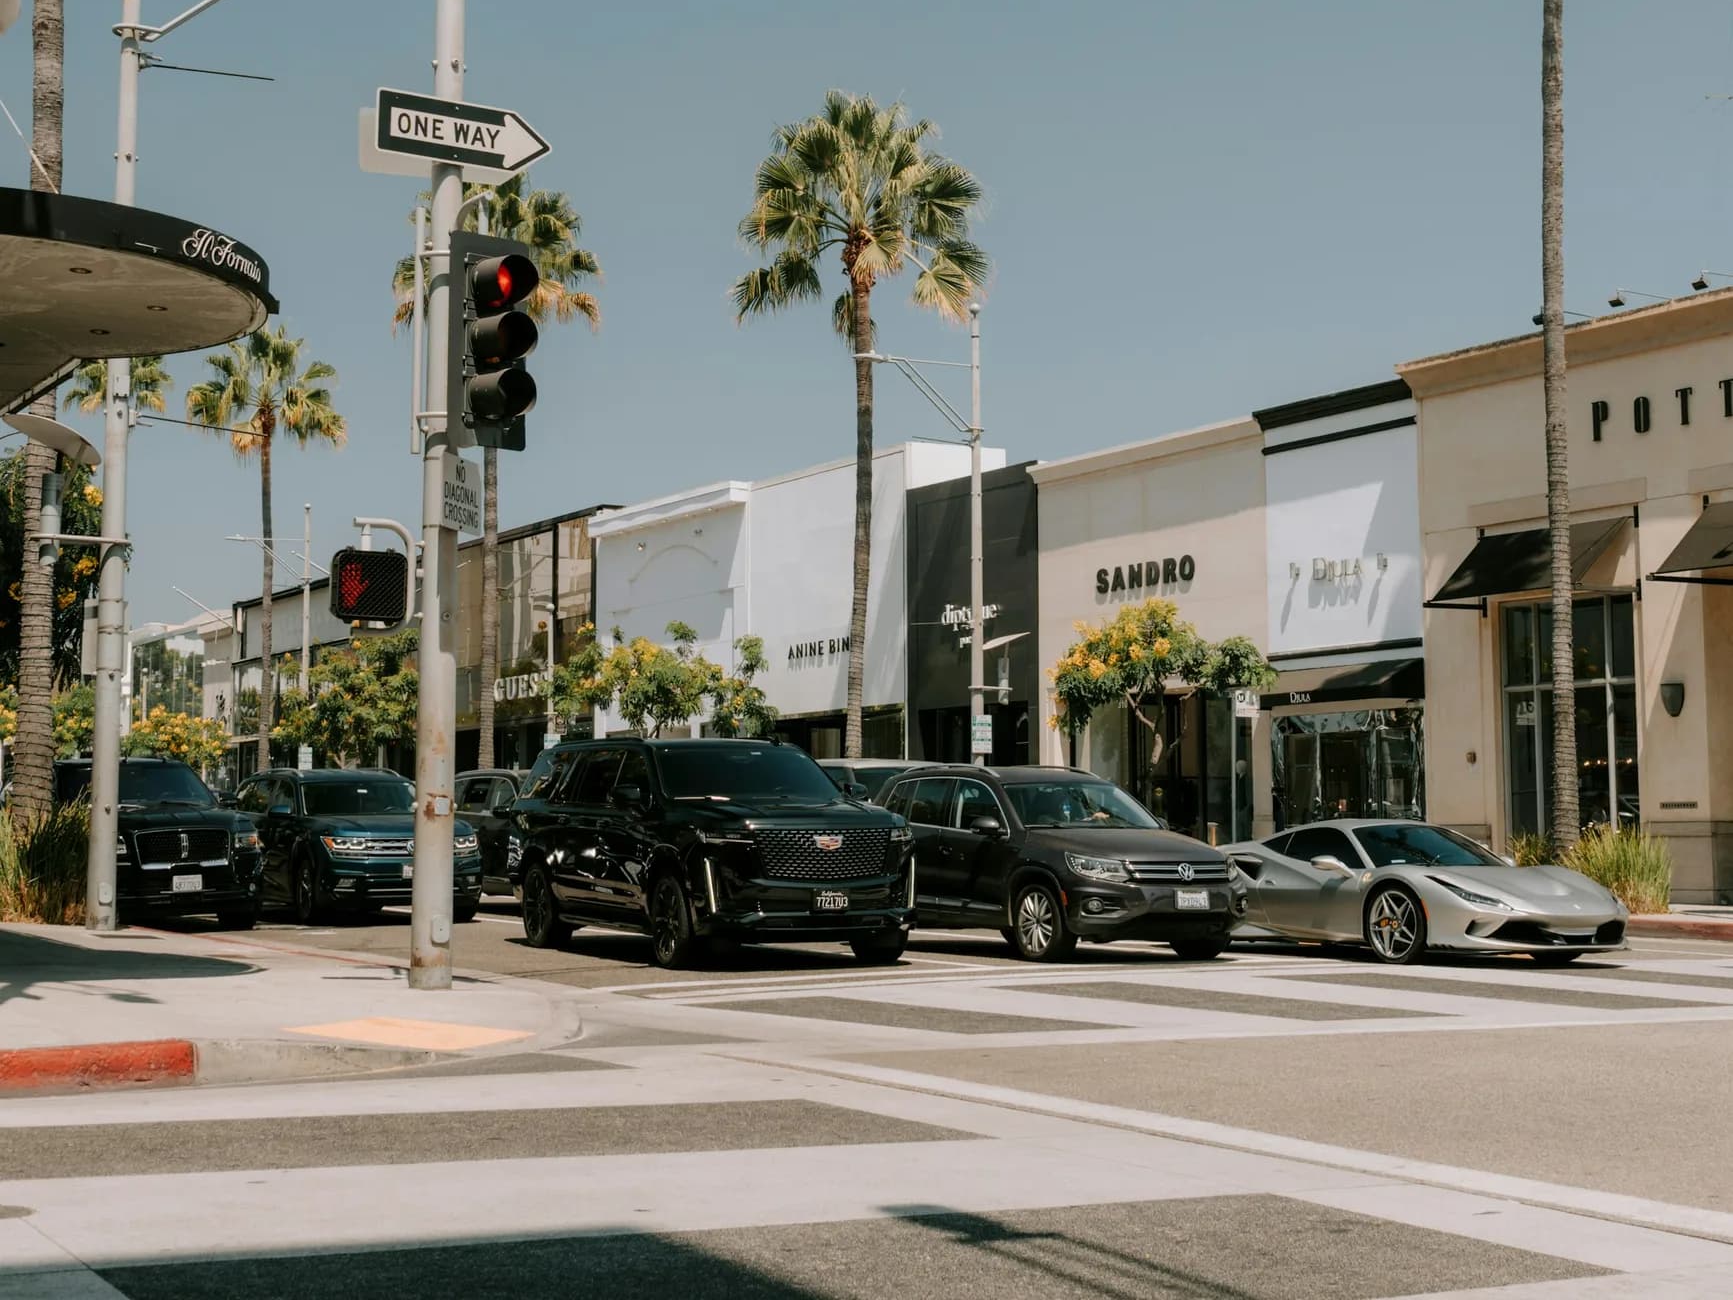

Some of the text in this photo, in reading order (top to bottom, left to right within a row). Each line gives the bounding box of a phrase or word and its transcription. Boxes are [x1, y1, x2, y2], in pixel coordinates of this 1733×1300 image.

[397, 113, 500, 149] ONE WAY
[212, 235, 261, 283] Fornaio
[455, 463, 466, 483] NO
[443, 481, 479, 508] DIAGONAL
[443, 501, 479, 529] CROSSING
[1096, 554, 1195, 594] SANDRO
[941, 604, 998, 631] diptyue
[788, 636, 852, 660] ANINE BIN
